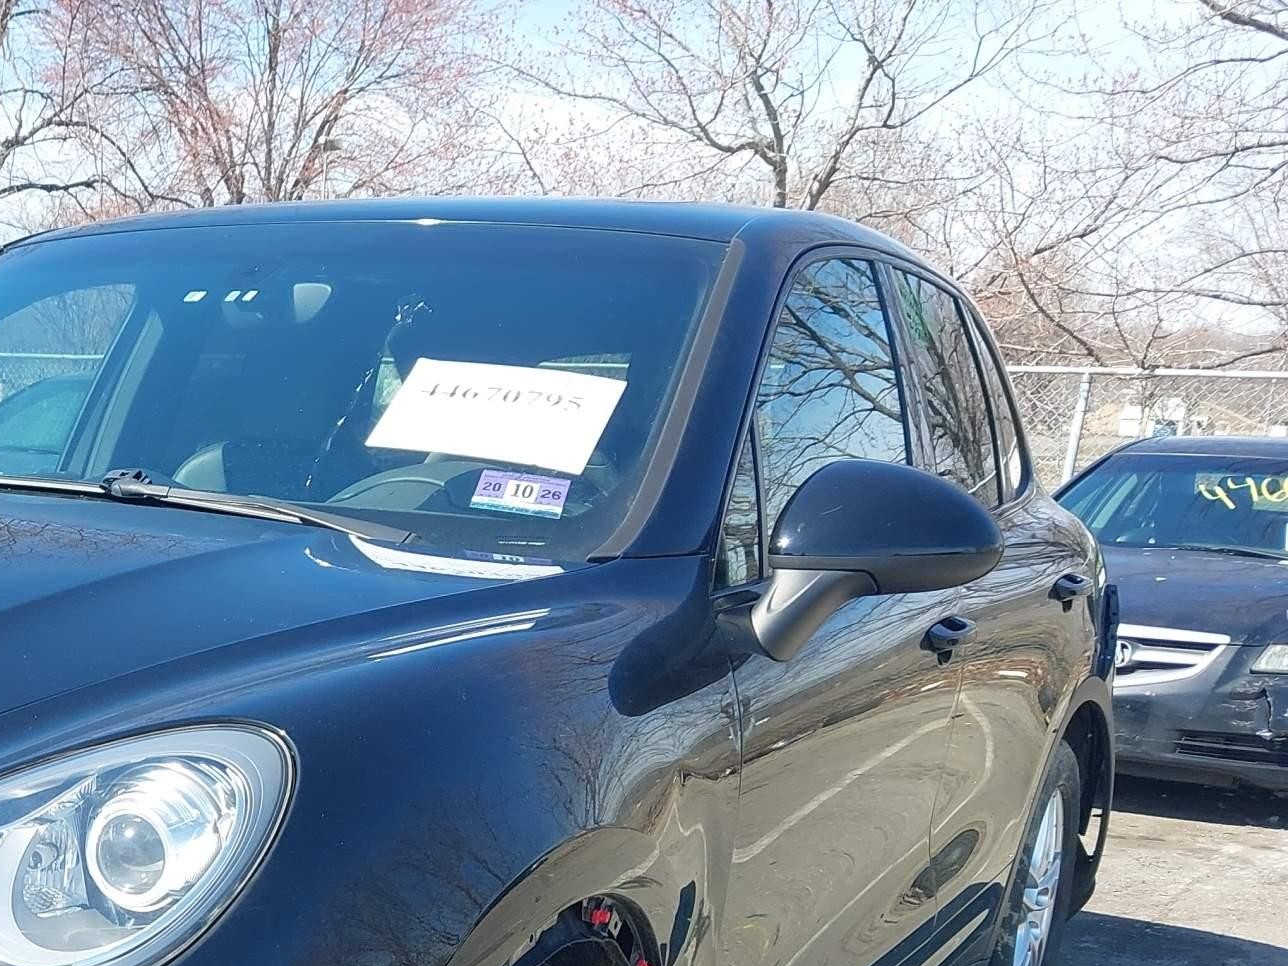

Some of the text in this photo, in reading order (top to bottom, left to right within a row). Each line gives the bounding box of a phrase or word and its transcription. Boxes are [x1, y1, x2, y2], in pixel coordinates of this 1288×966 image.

[482, 481, 562, 501] 20 10 26
